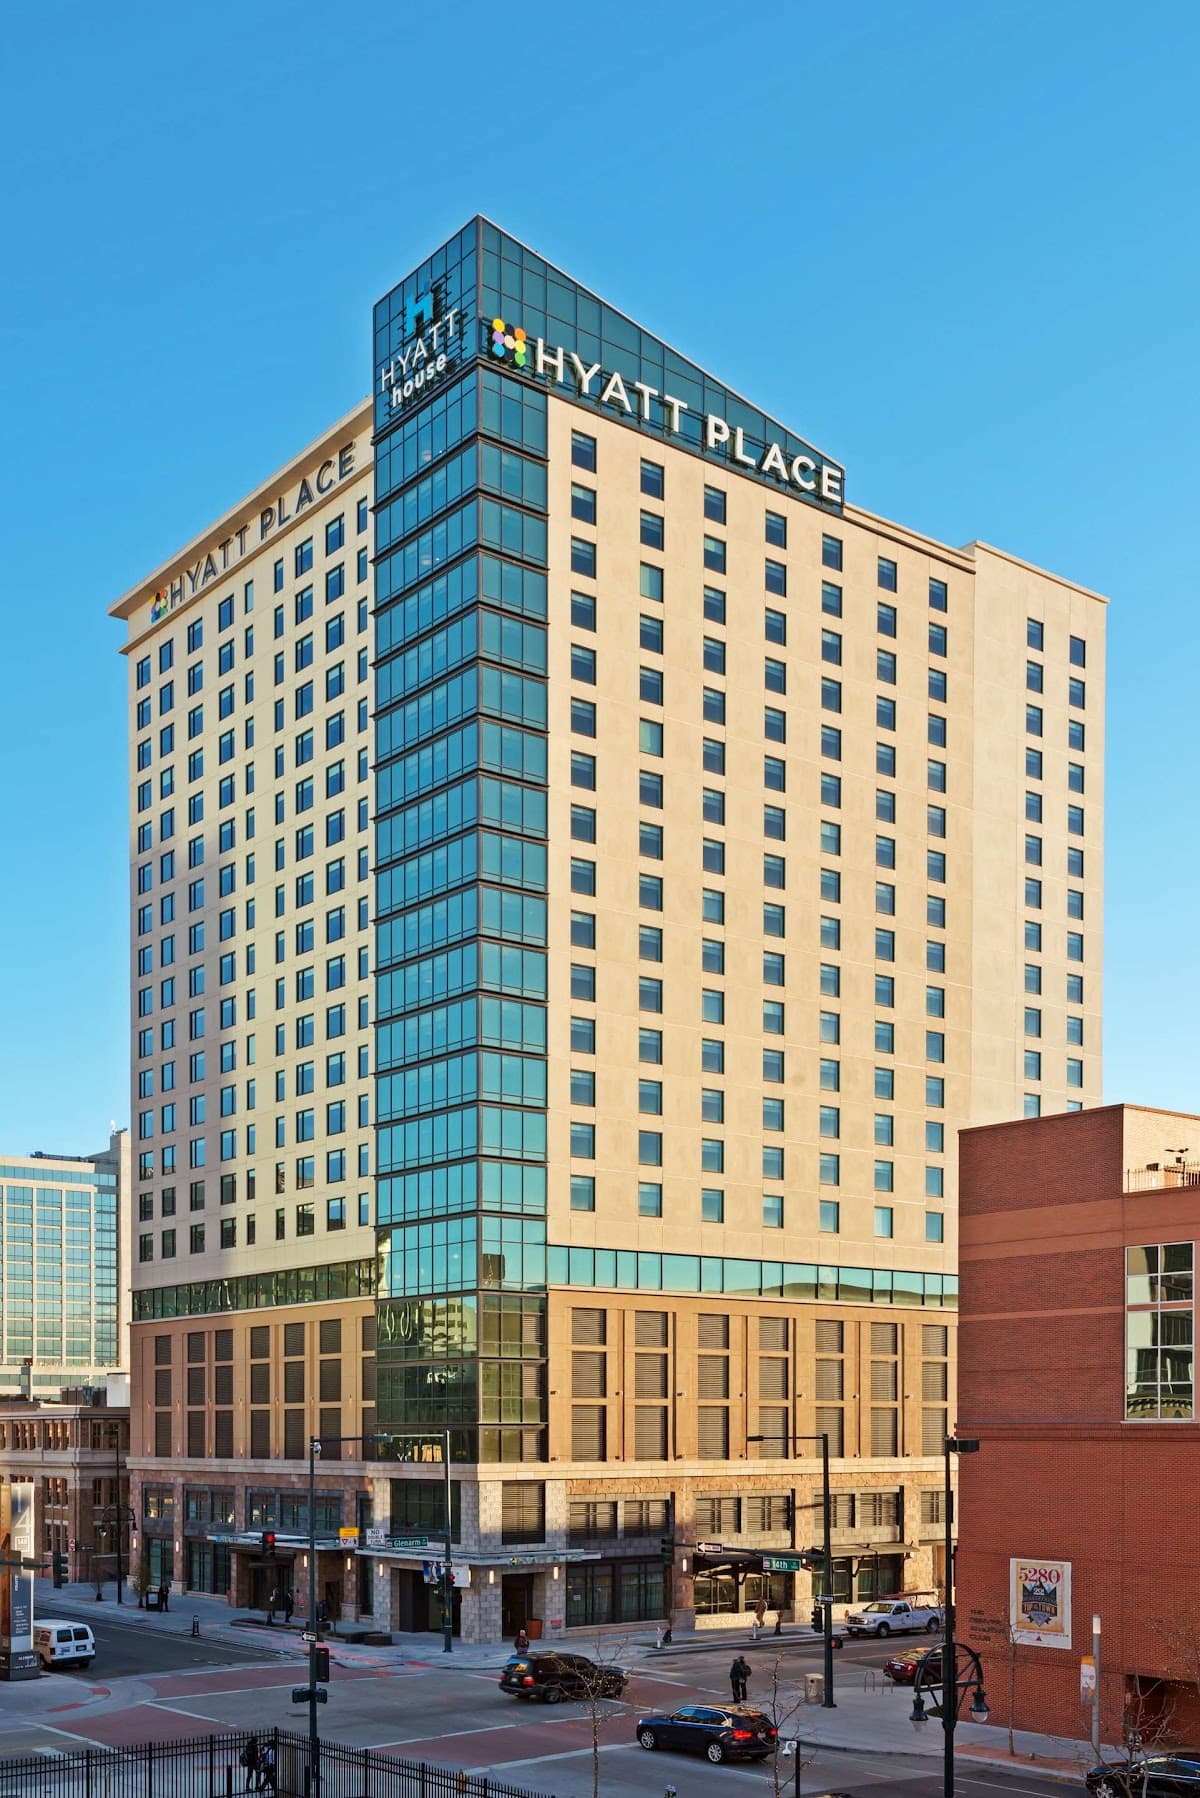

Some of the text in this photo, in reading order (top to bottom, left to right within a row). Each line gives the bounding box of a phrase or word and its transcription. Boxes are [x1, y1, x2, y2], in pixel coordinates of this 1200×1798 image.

[381, 308, 460, 392] HYATT
[391, 353, 447, 407] house
[536, 337, 843, 502] HYATT PLACE
[170, 441, 356, 609] HYATT PLACE
[394, 1539, 421, 1547] Glenarm
[772, 1560, 788, 1569] 14th
[1019, 1567, 1061, 1584] 5280
